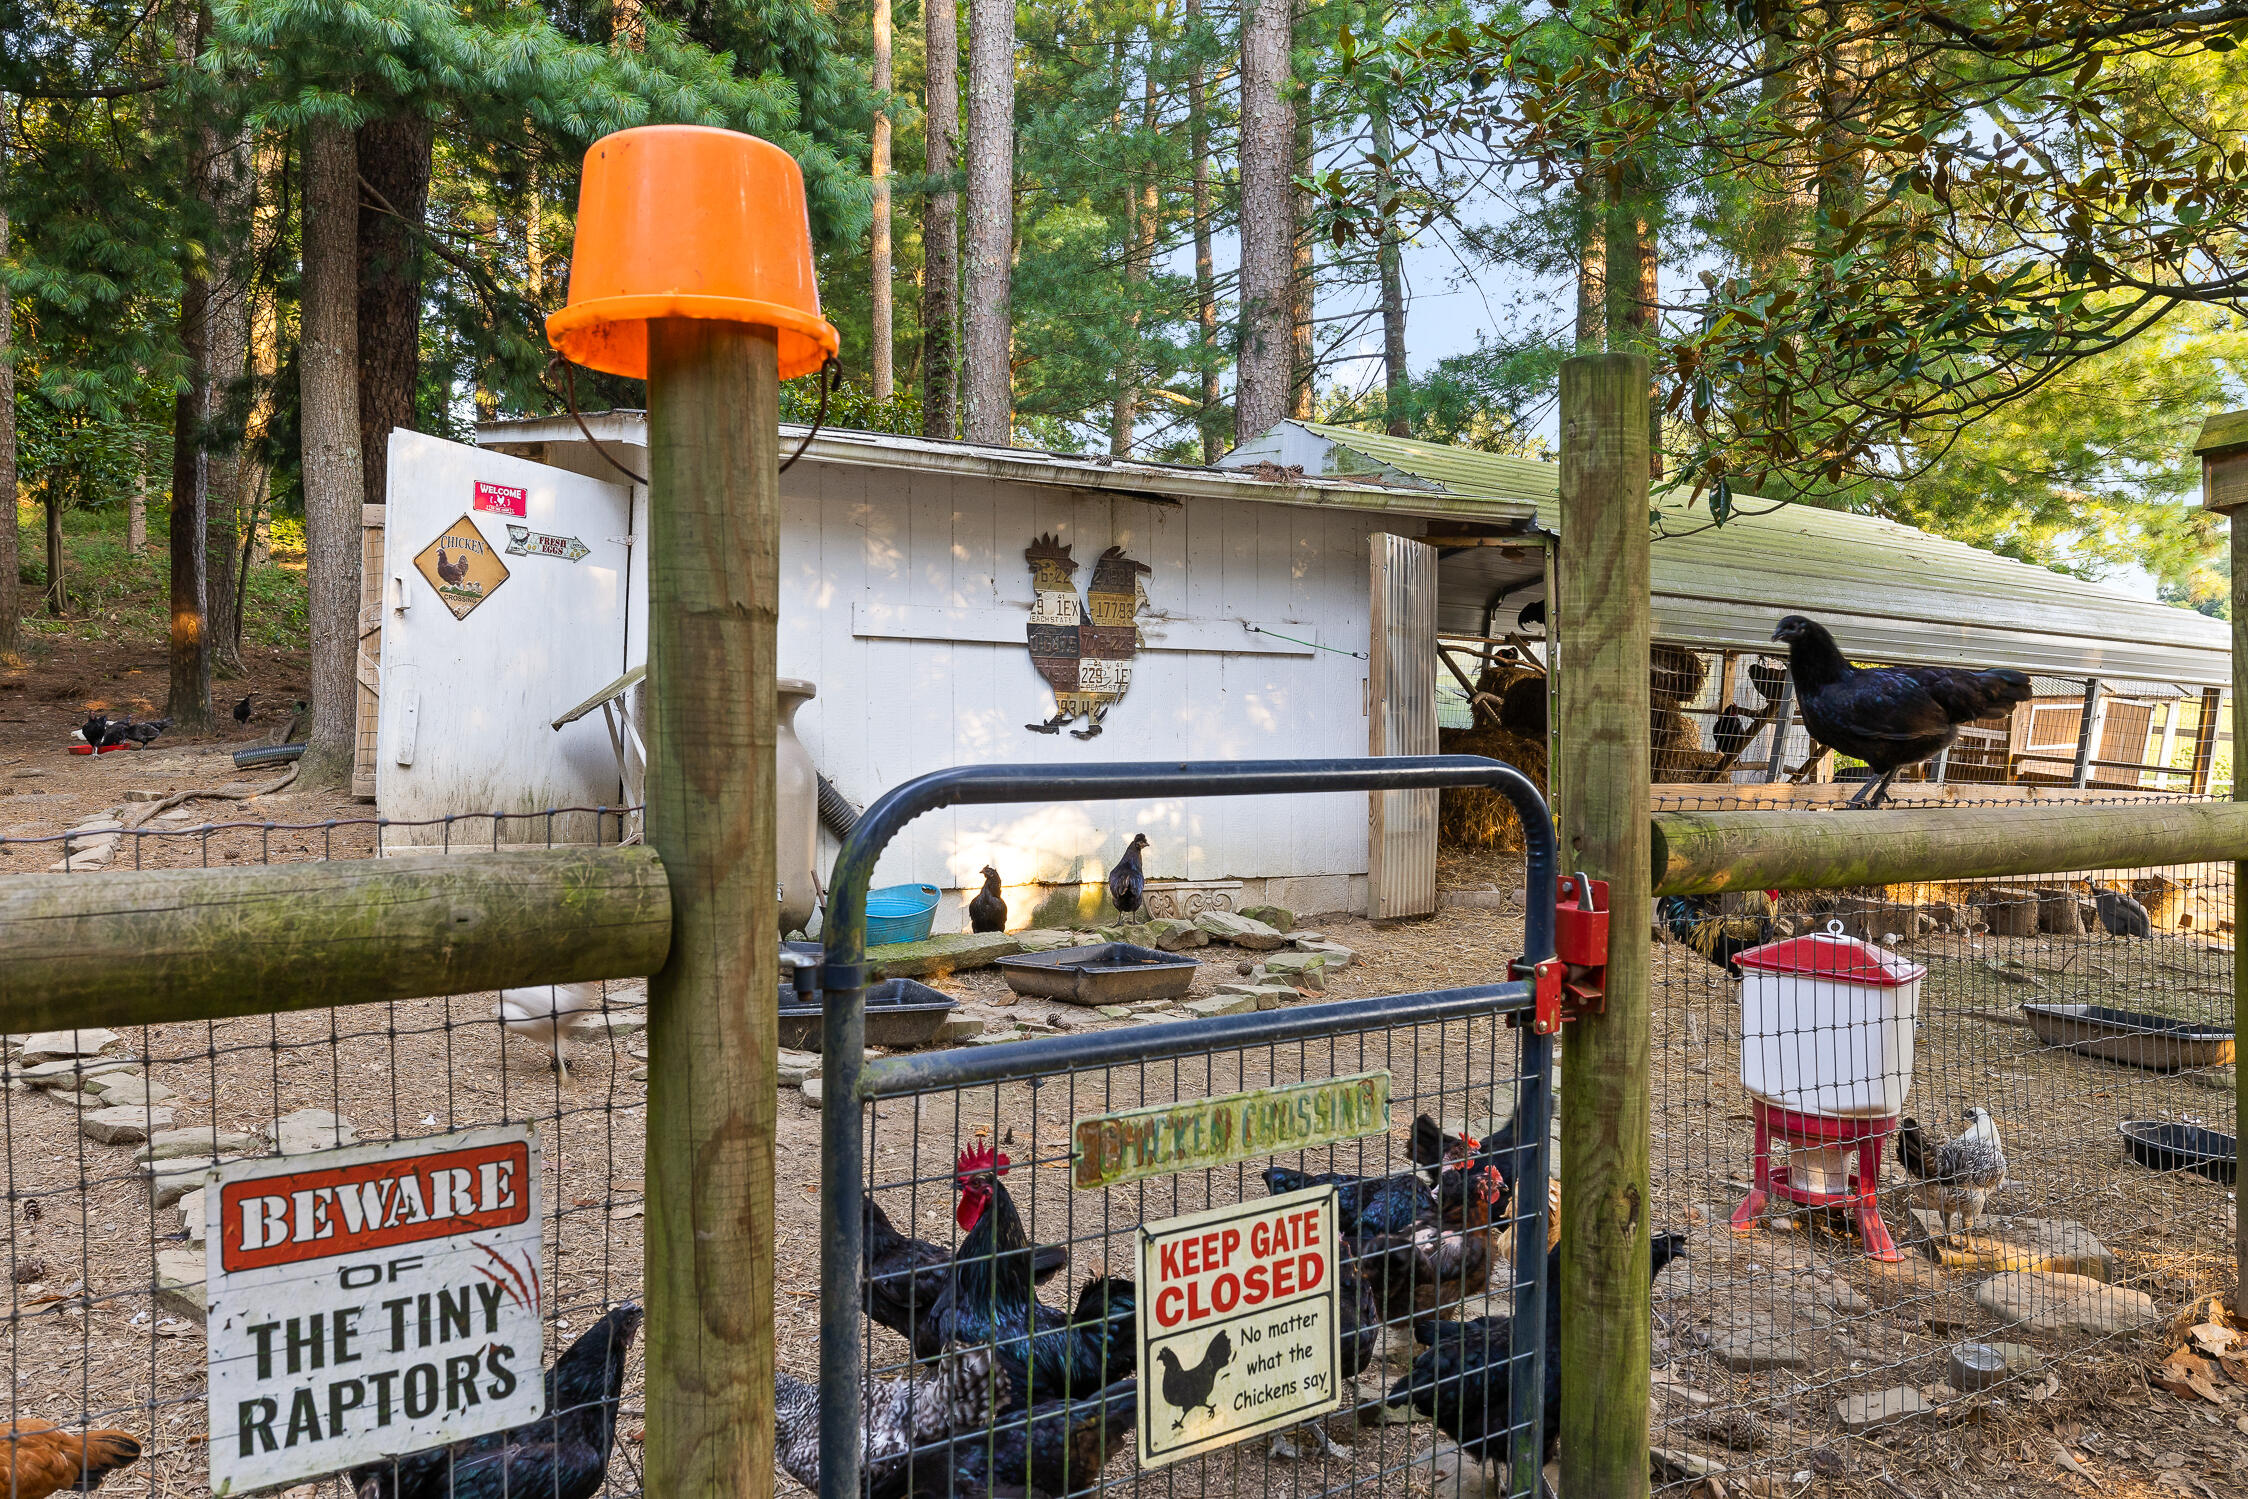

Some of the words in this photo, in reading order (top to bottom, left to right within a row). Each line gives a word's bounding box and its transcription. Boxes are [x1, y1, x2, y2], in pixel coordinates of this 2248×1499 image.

[480, 484, 522, 500] WELCOME
[440, 535, 485, 556] CHICKEN
[539, 536, 567, 548] FRESH
[542, 545, 563, 556] EGGS
[444, 593, 478, 605] CROSSING
[1057, 600, 1079, 617] 1EX
[239, 1158, 516, 1252] BEWARE
[1160, 1228, 1241, 1282] KEEP
[1250, 1208, 1321, 1260] GATE
[340, 1254, 424, 1290] OF
[1155, 1251, 1325, 1328] CLOSED
[246, 1304, 364, 1381] THE
[381, 1278, 508, 1354] TINY
[1240, 1327, 1262, 1347] No
[1268, 1311, 1319, 1338] matter
[1246, 1351, 1283, 1377] what
[1288, 1342, 1314, 1364] the
[238, 1344, 518, 1459] RAPTORS
[1233, 1378, 1297, 1412] Chickens
